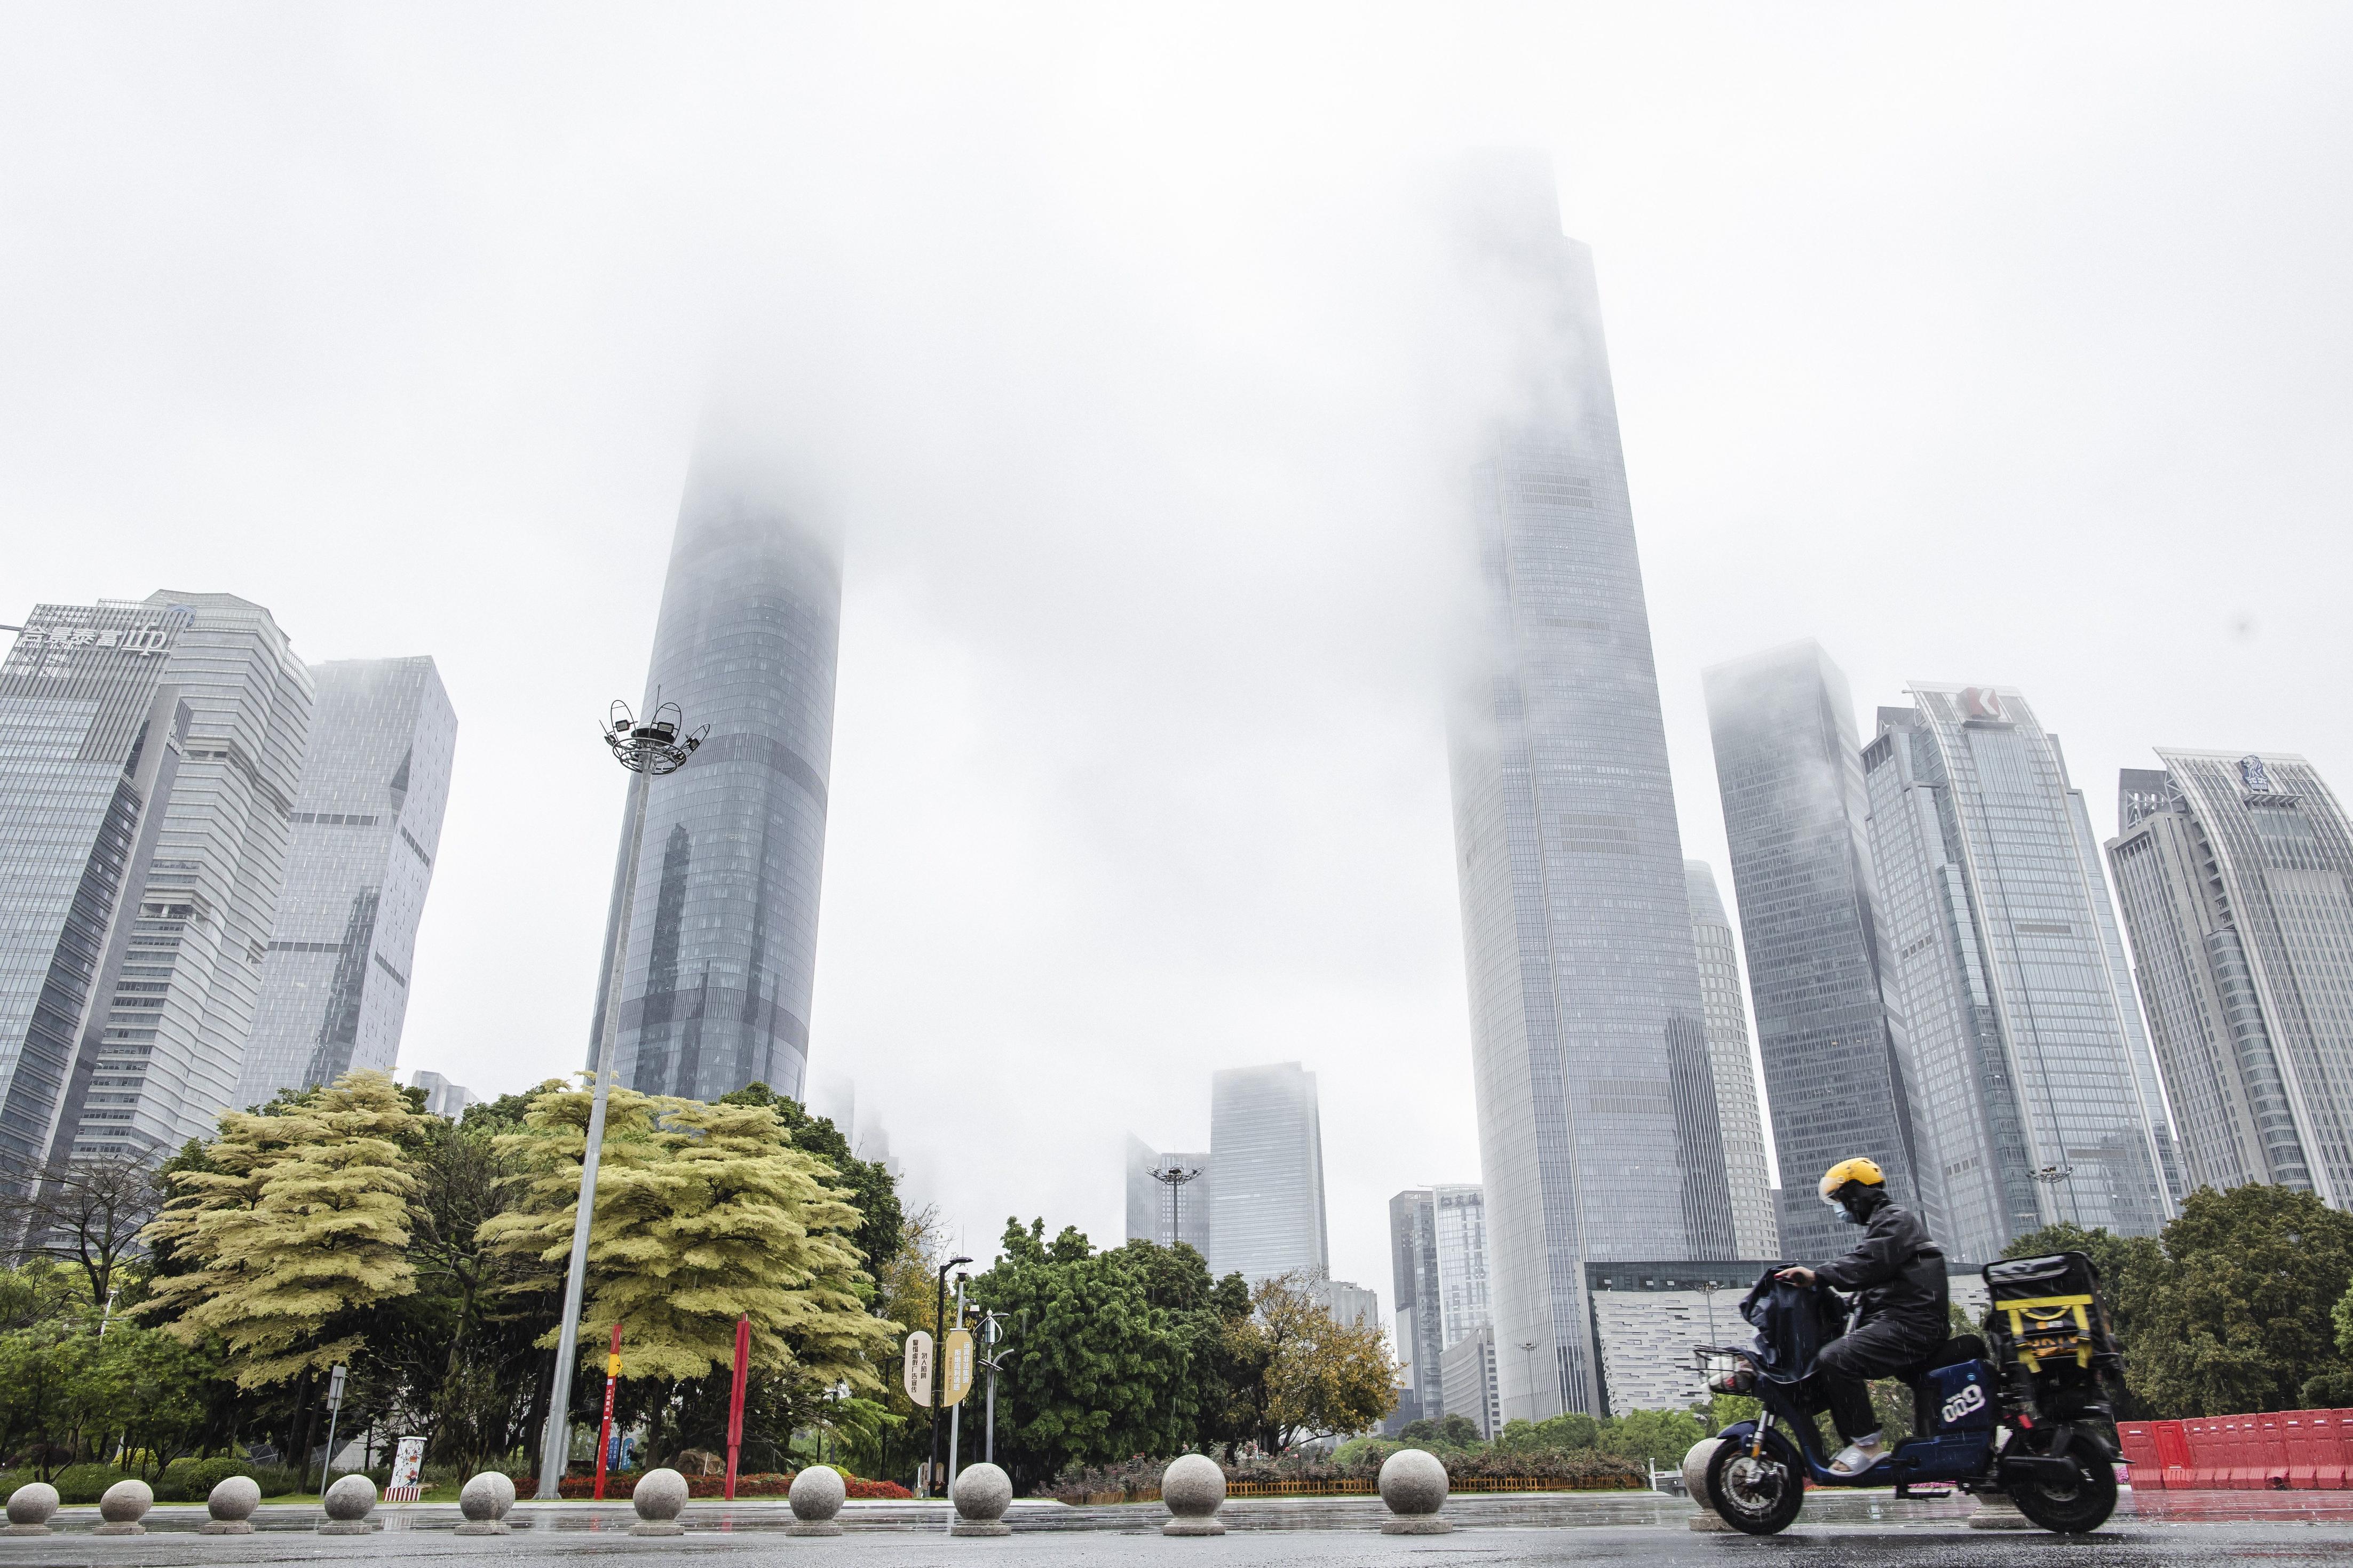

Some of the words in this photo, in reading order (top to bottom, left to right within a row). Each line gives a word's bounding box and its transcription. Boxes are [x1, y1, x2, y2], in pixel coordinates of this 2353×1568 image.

[22, 625, 123, 647] 合景泰富
[122, 622, 169, 656] ifp
[962, 1342, 970, 1383] 远离非法集资
